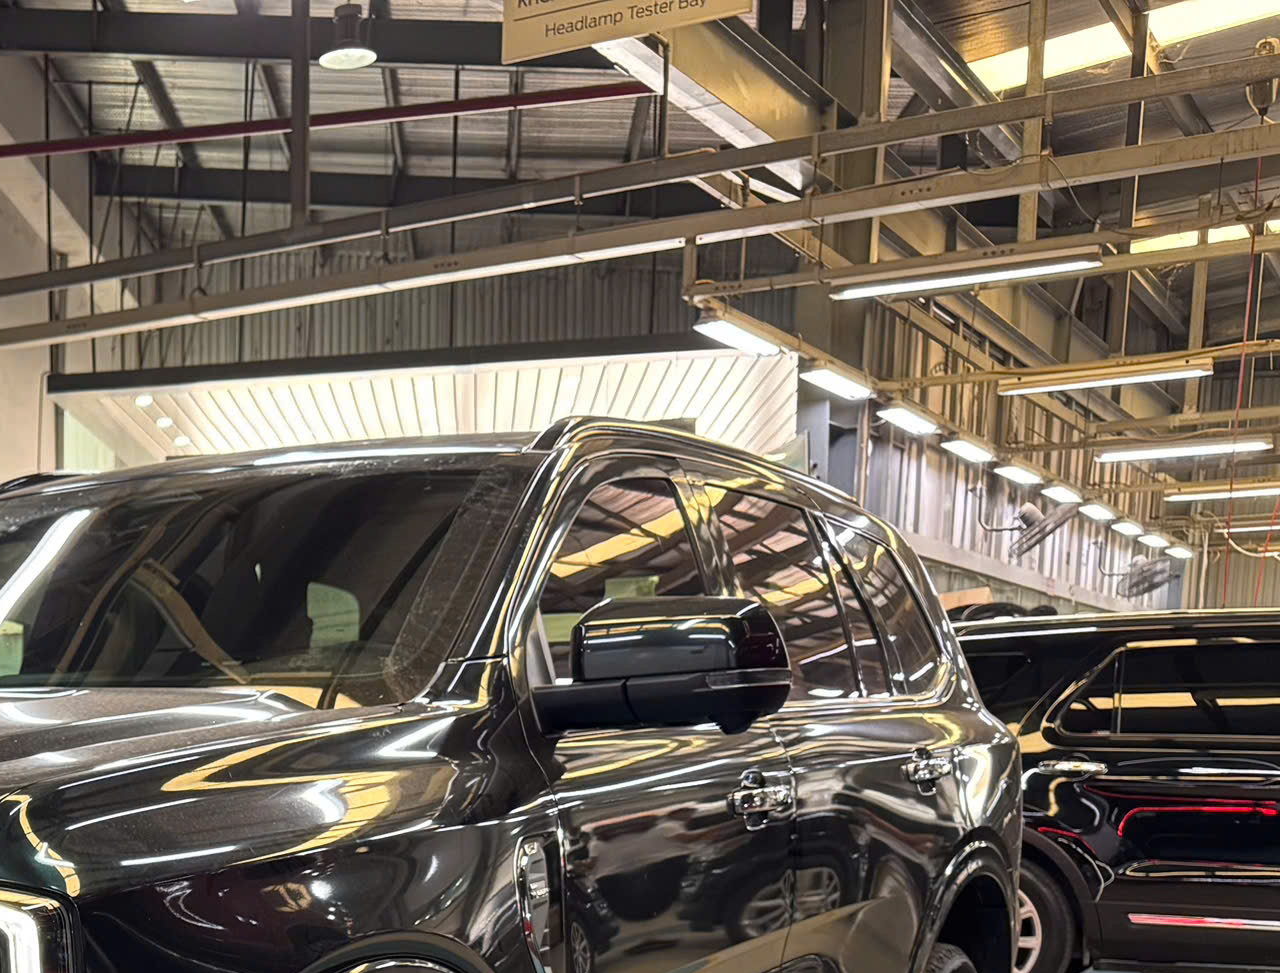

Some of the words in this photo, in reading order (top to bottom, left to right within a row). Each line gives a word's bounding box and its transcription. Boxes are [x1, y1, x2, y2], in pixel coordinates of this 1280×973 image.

[544, 11, 624, 37] Headlamp
[627, 0, 673, 20] Tester
[678, 0, 706, 9] Bay
